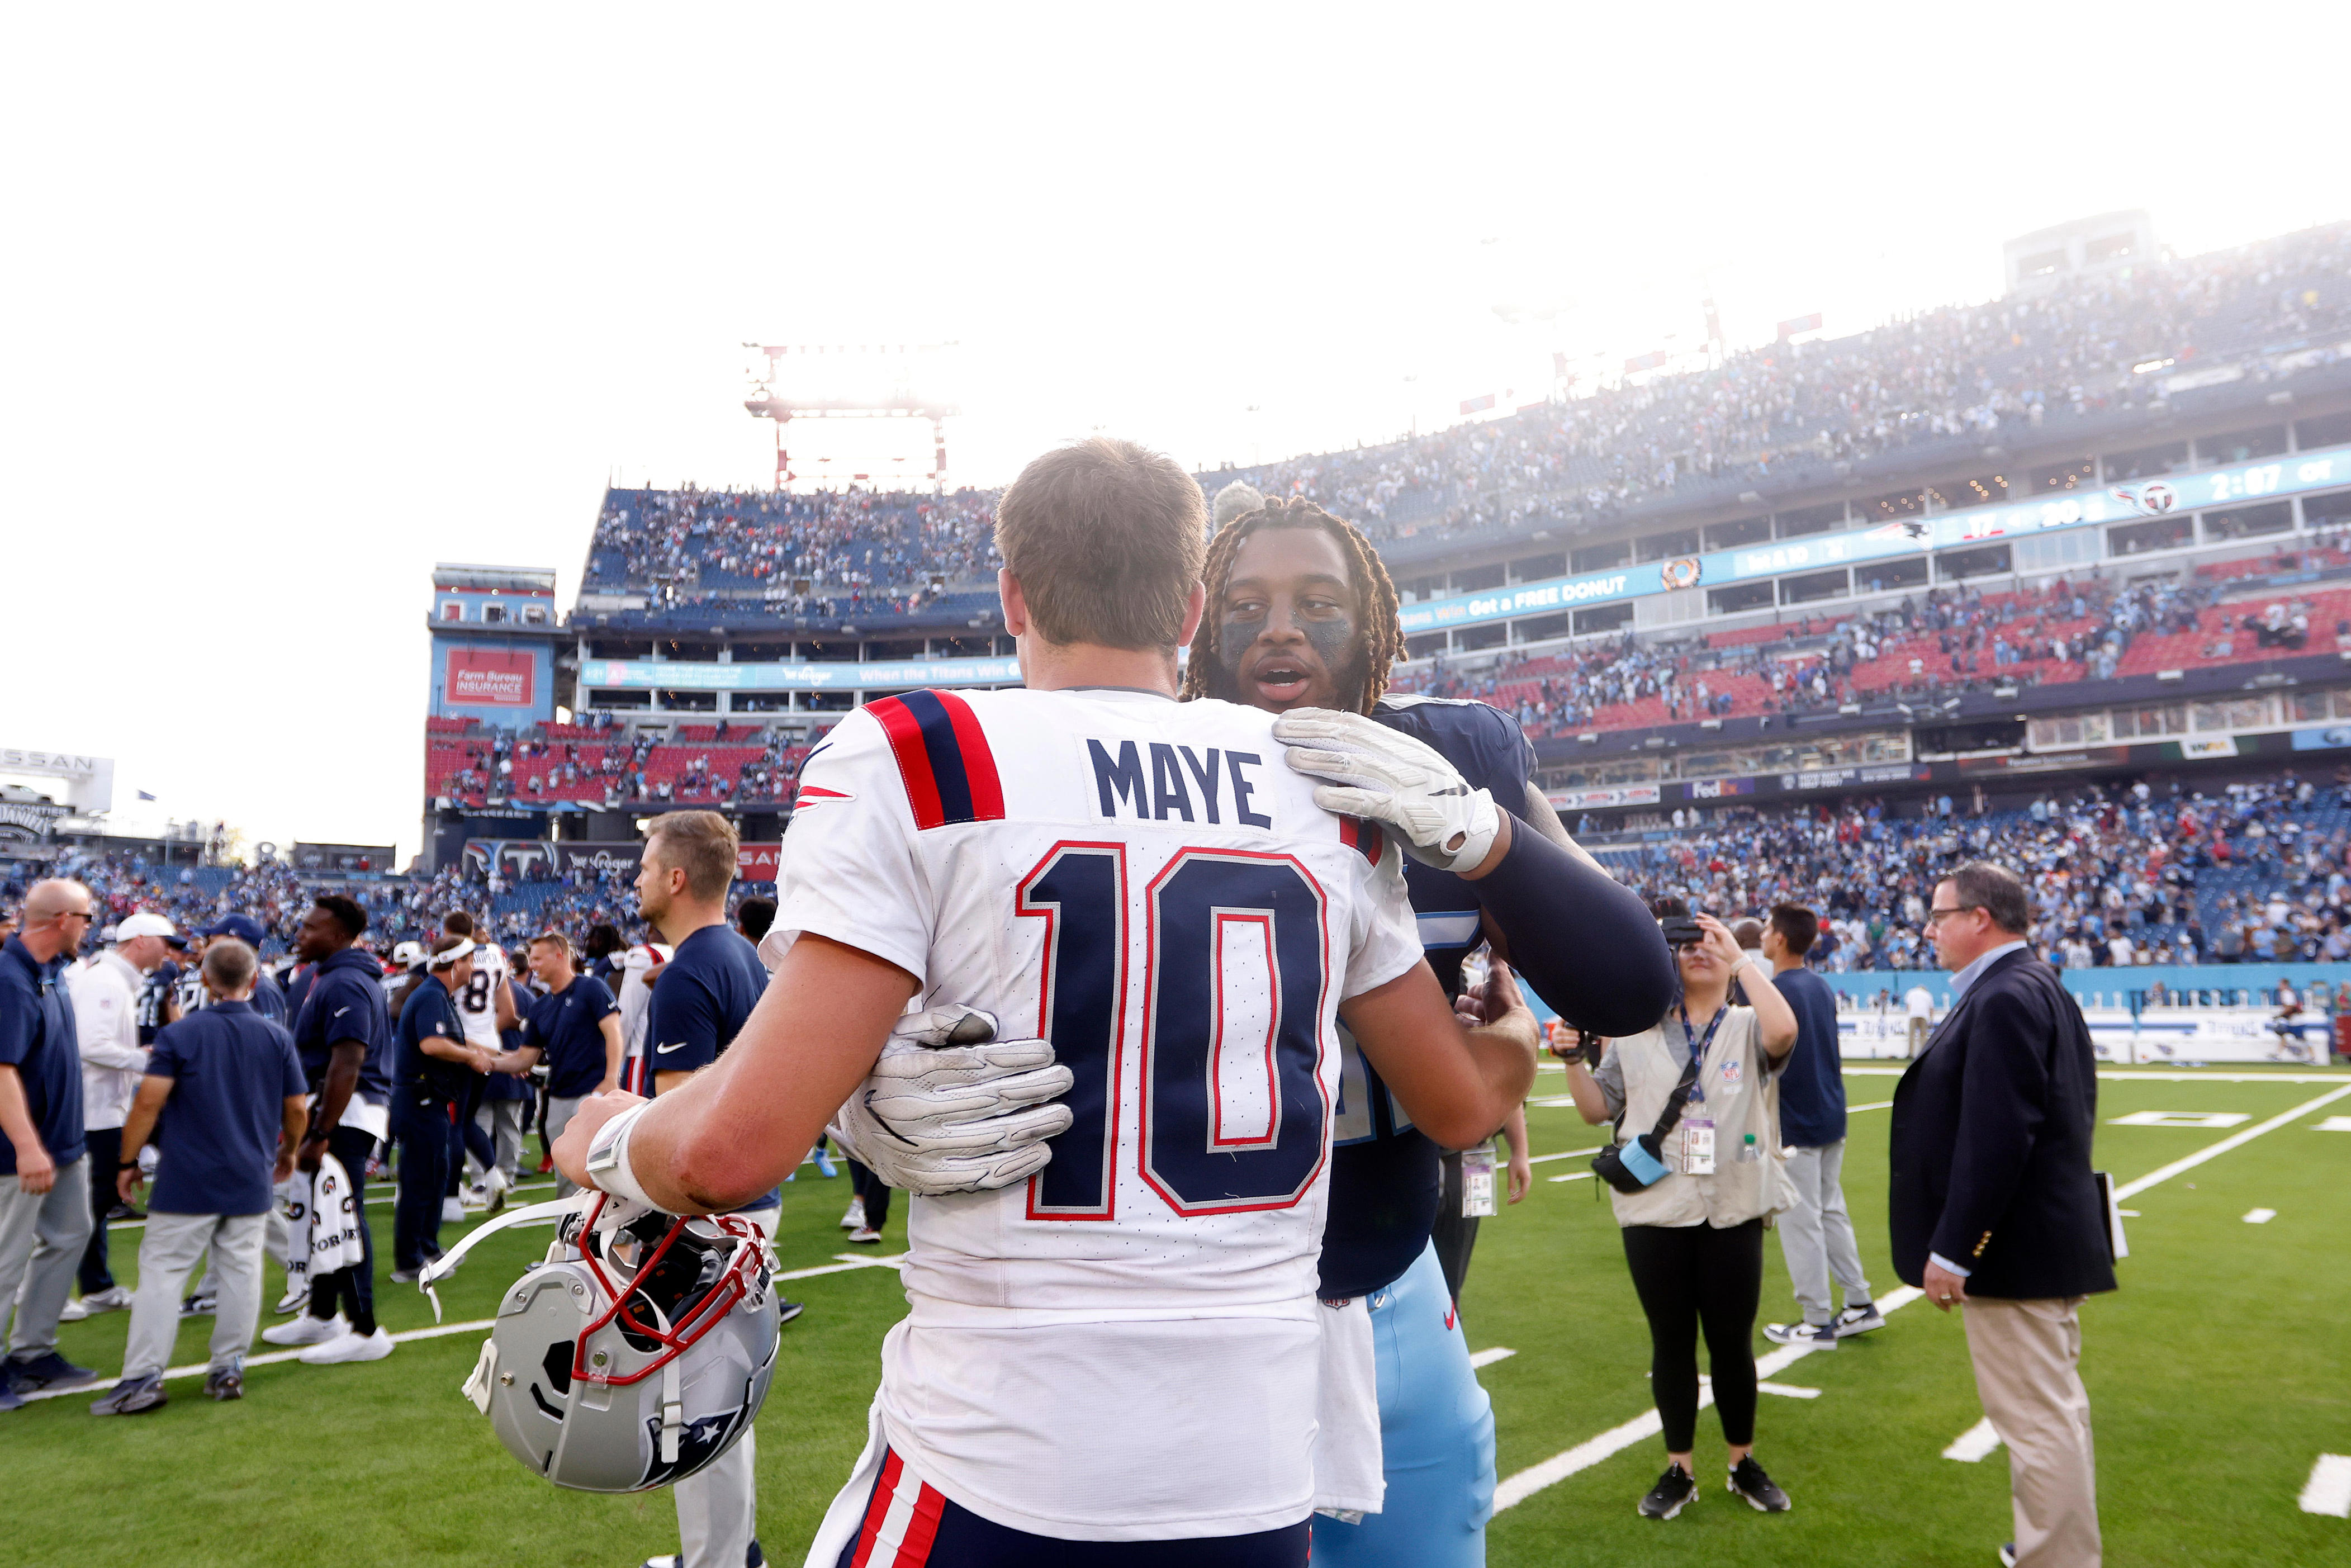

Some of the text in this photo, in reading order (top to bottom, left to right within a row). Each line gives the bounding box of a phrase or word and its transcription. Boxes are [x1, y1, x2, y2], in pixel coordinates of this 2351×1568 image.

[2209, 464, 2282, 500] 2:07
[1968, 513, 1997, 537] 17
[2041, 499, 2081, 528] 20
[1468, 599, 1499, 617] Get
[1501, 599, 1512, 612] a
[1515, 587, 1559, 609] FREE
[1562, 576, 1627, 602] DONUT
[458, 669, 523, 683] Farm Bureau
[798, 665, 832, 687] Kroger
[860, 669, 900, 682] When
[903, 667, 926, 680] the
[930, 665, 974, 680] Titans
[977, 664, 1006, 678] Win
[456, 681, 522, 694] INSURANCE
[1087, 738, 1272, 830] MAYE
[1692, 779, 1739, 799] FedEx
[589, 849, 634, 877] Kroger
[1016, 840, 1329, 1220] 10
